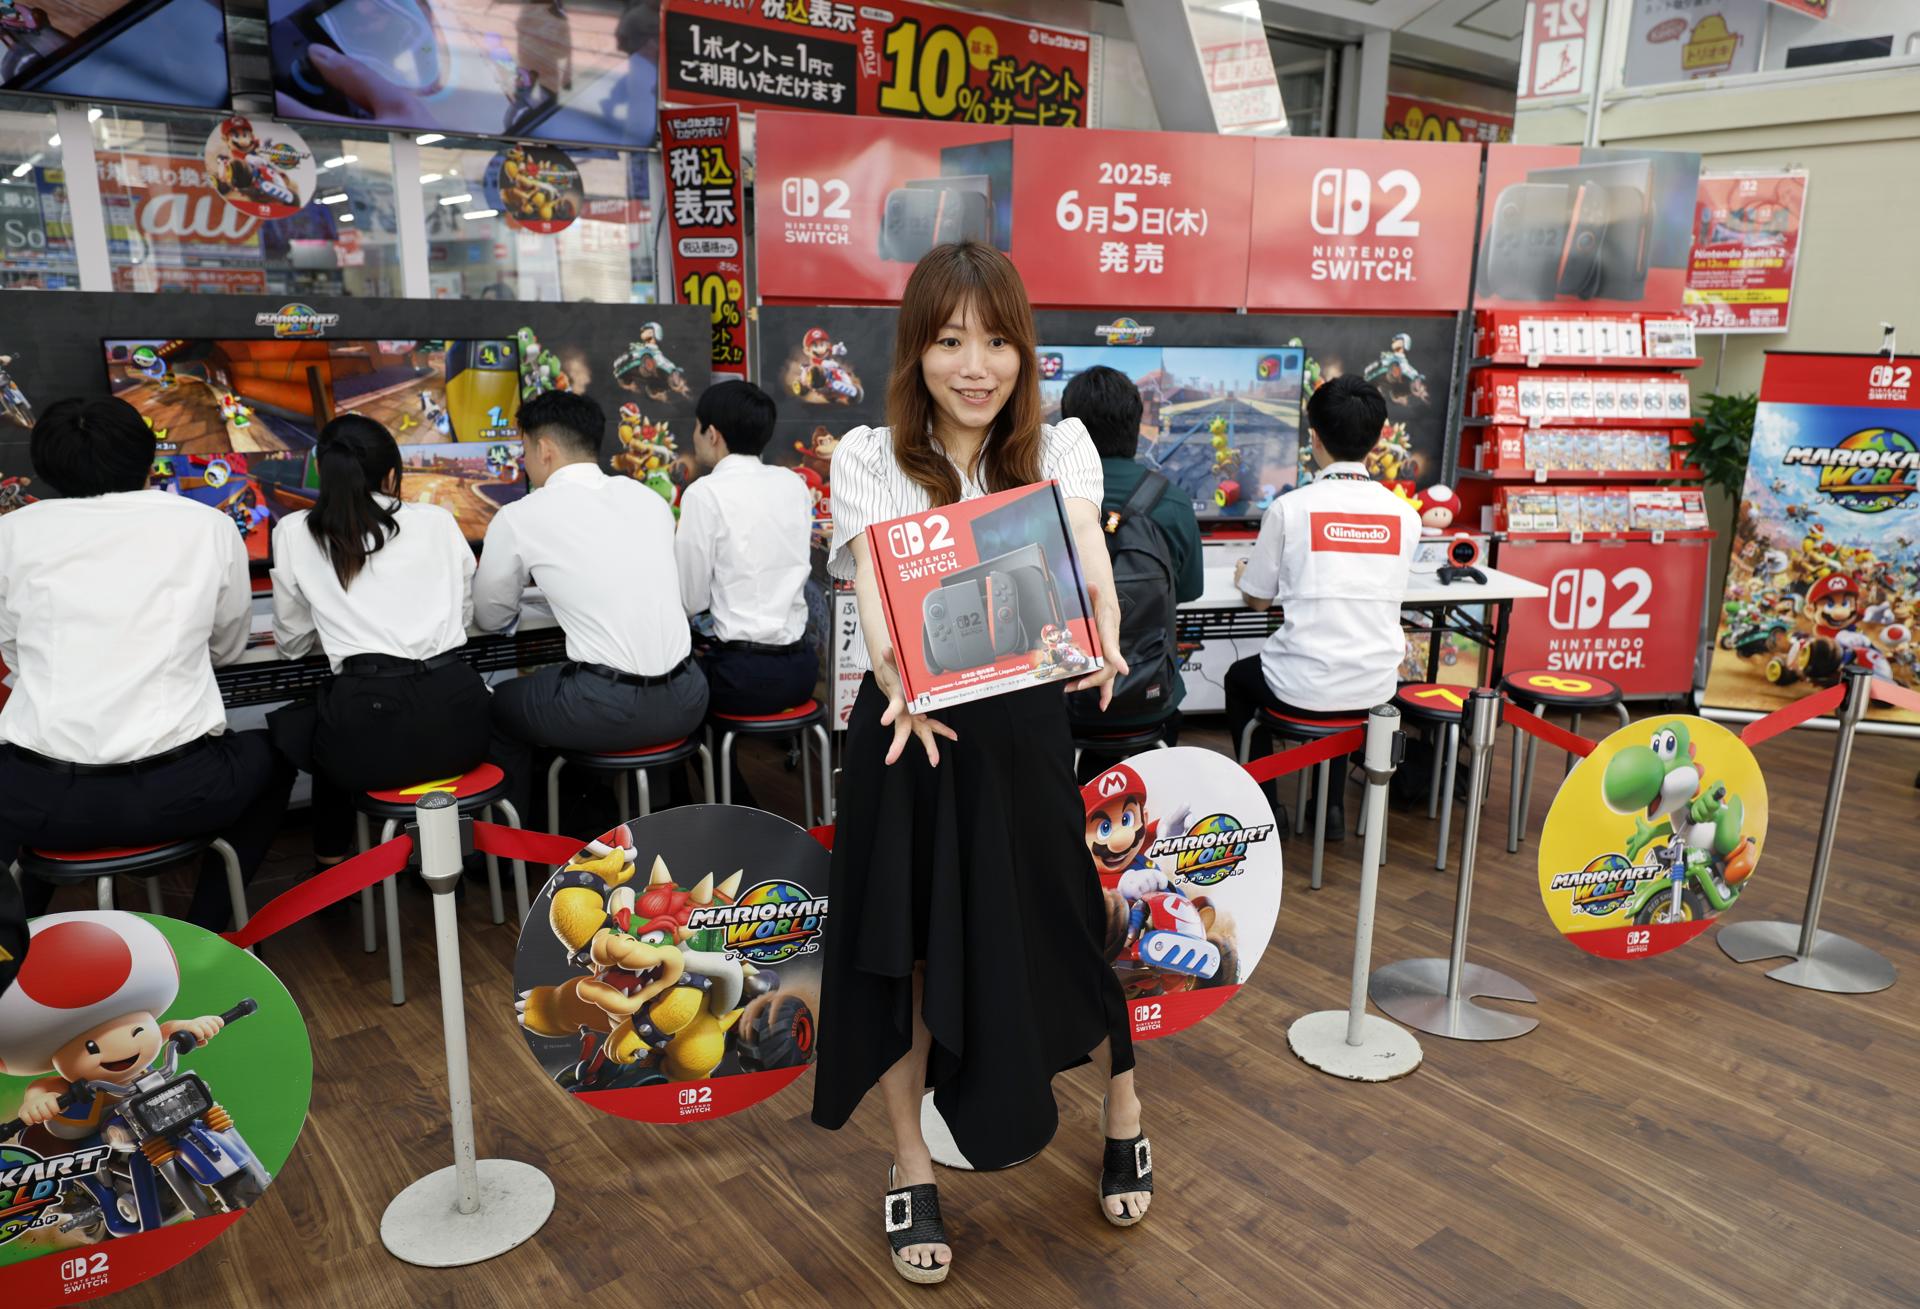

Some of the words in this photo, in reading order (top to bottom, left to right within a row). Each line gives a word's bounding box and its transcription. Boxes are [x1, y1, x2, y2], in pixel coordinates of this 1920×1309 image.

[761, 0, 857, 32] 税込表示
[860, 27, 877, 76] さらに
[679, 60, 847, 104] ご利用いただけます
[991, 60, 1081, 101] ポイント
[990, 97, 1079, 127] サービス
[669, 147, 734, 187] 税込
[1098, 162, 1172, 187] 2025年
[674, 187, 736, 226] 表示
[822, 179, 851, 219] 2
[1375, 168, 1422, 237] 2
[1055, 189, 1209, 236] 6月5日(木)
[784, 222, 849, 231] NINTENDO
[784, 231, 850, 245] SWITCH
[1099, 241, 1165, 274] 発売
[1312, 245, 1414, 260] NINTENDO
[1311, 259, 1413, 282] SWITCH
[1819, 465, 1919, 487] WORLD
[923, 514, 956, 551] 2
[1329, 526, 1386, 541] Nintendo
[897, 551, 956, 572] NINTENDO
[899, 558, 959, 582] SWITCH
[1608, 566, 1653, 629] 2
[1549, 637, 1645, 650] NINTENDO
[1547, 650, 1643, 670] SWITCH
[980, 671, 999, 681] System
[1151, 824, 1273, 857] MARIOKART
[1177, 841, 1247, 870] WORLD
[1551, 865, 1660, 889] MARIOKART
[1574, 879, 1635, 900] WORLD
[726, 915, 818, 944] WORLD
[725, 944, 819, 960] マリオカートワールド
[1135, 1023, 1161, 1033] SWITCH
[698, 1086, 713, 1103] 2
[679, 1107, 712, 1116] SWITCH
[89, 1252, 110, 1275] 2
[63, 1273, 108, 1288] NINTENDO
[63, 1277, 109, 1295] SWITCH
